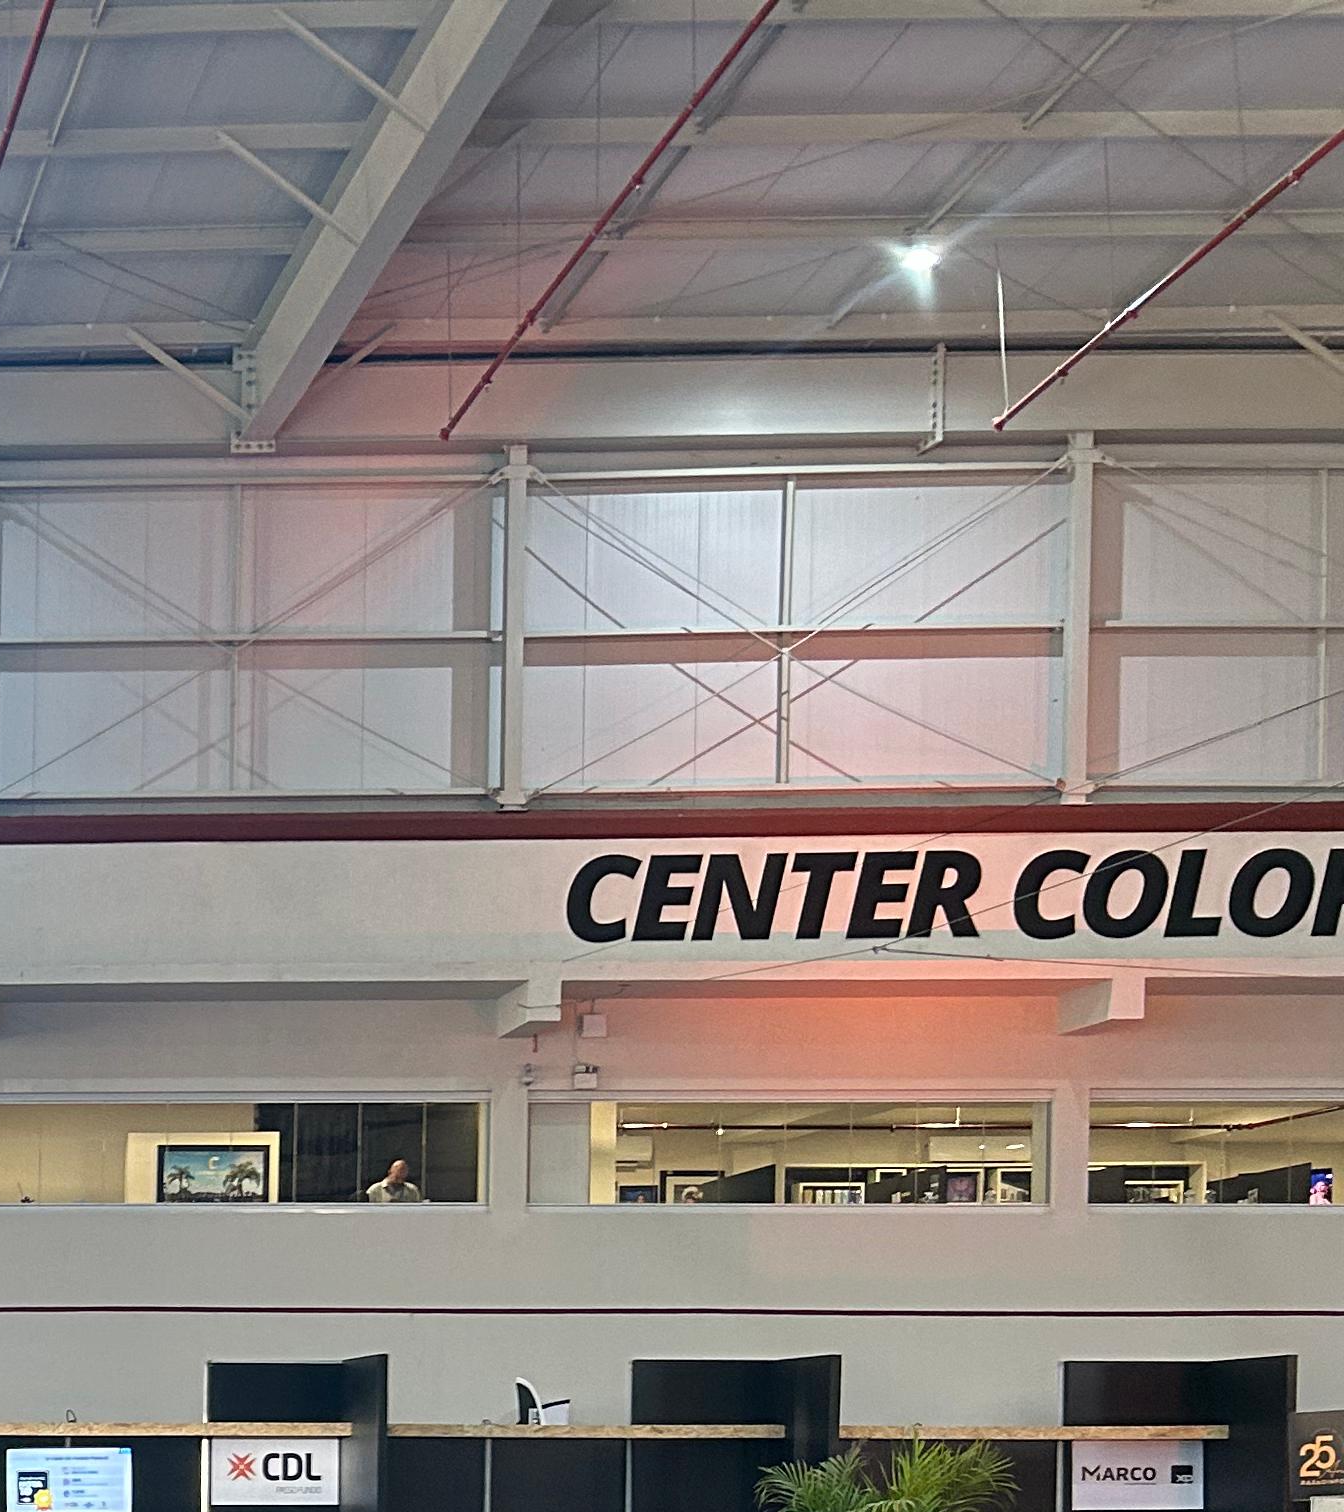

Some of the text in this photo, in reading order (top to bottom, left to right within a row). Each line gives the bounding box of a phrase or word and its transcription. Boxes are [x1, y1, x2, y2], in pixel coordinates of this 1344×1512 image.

[565, 848, 983, 942] CENTER
[263, 1452, 322, 1482] CDL
[1081, 1464, 1157, 1482] MARCO
[1300, 1434, 1336, 1477] 25
